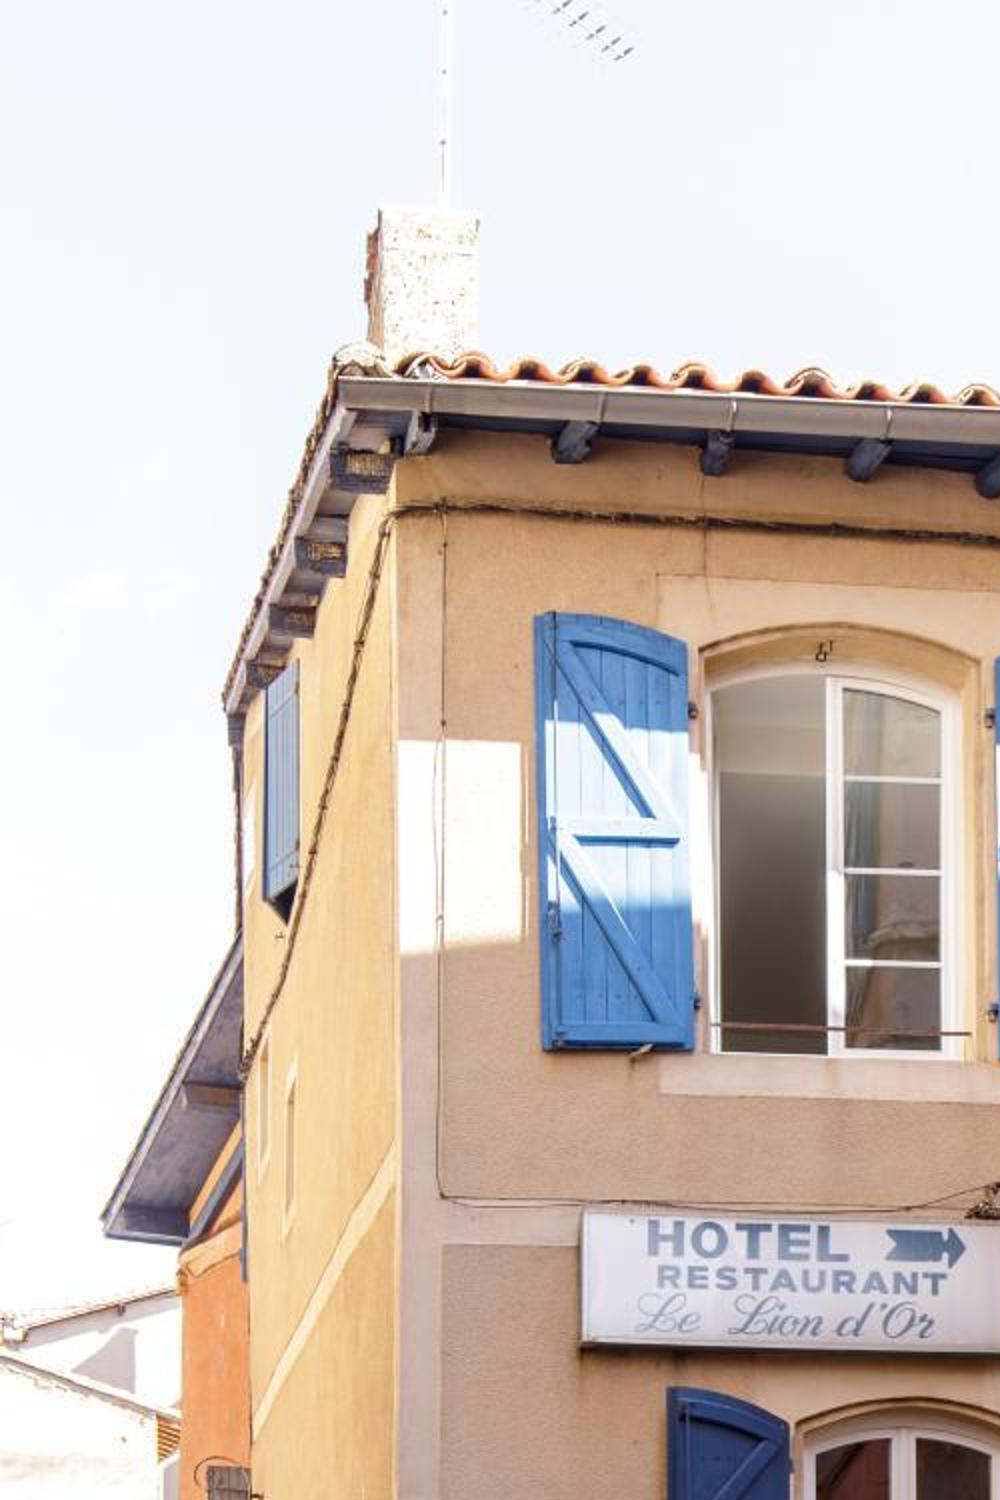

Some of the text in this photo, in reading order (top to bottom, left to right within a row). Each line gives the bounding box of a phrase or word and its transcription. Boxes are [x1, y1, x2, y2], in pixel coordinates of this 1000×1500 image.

[647, 1219, 849, 1263] HOTEL
[656, 1264, 948, 1296] RESTAURANT
[636, 1293, 936, 1340] Le Lion d'Or
